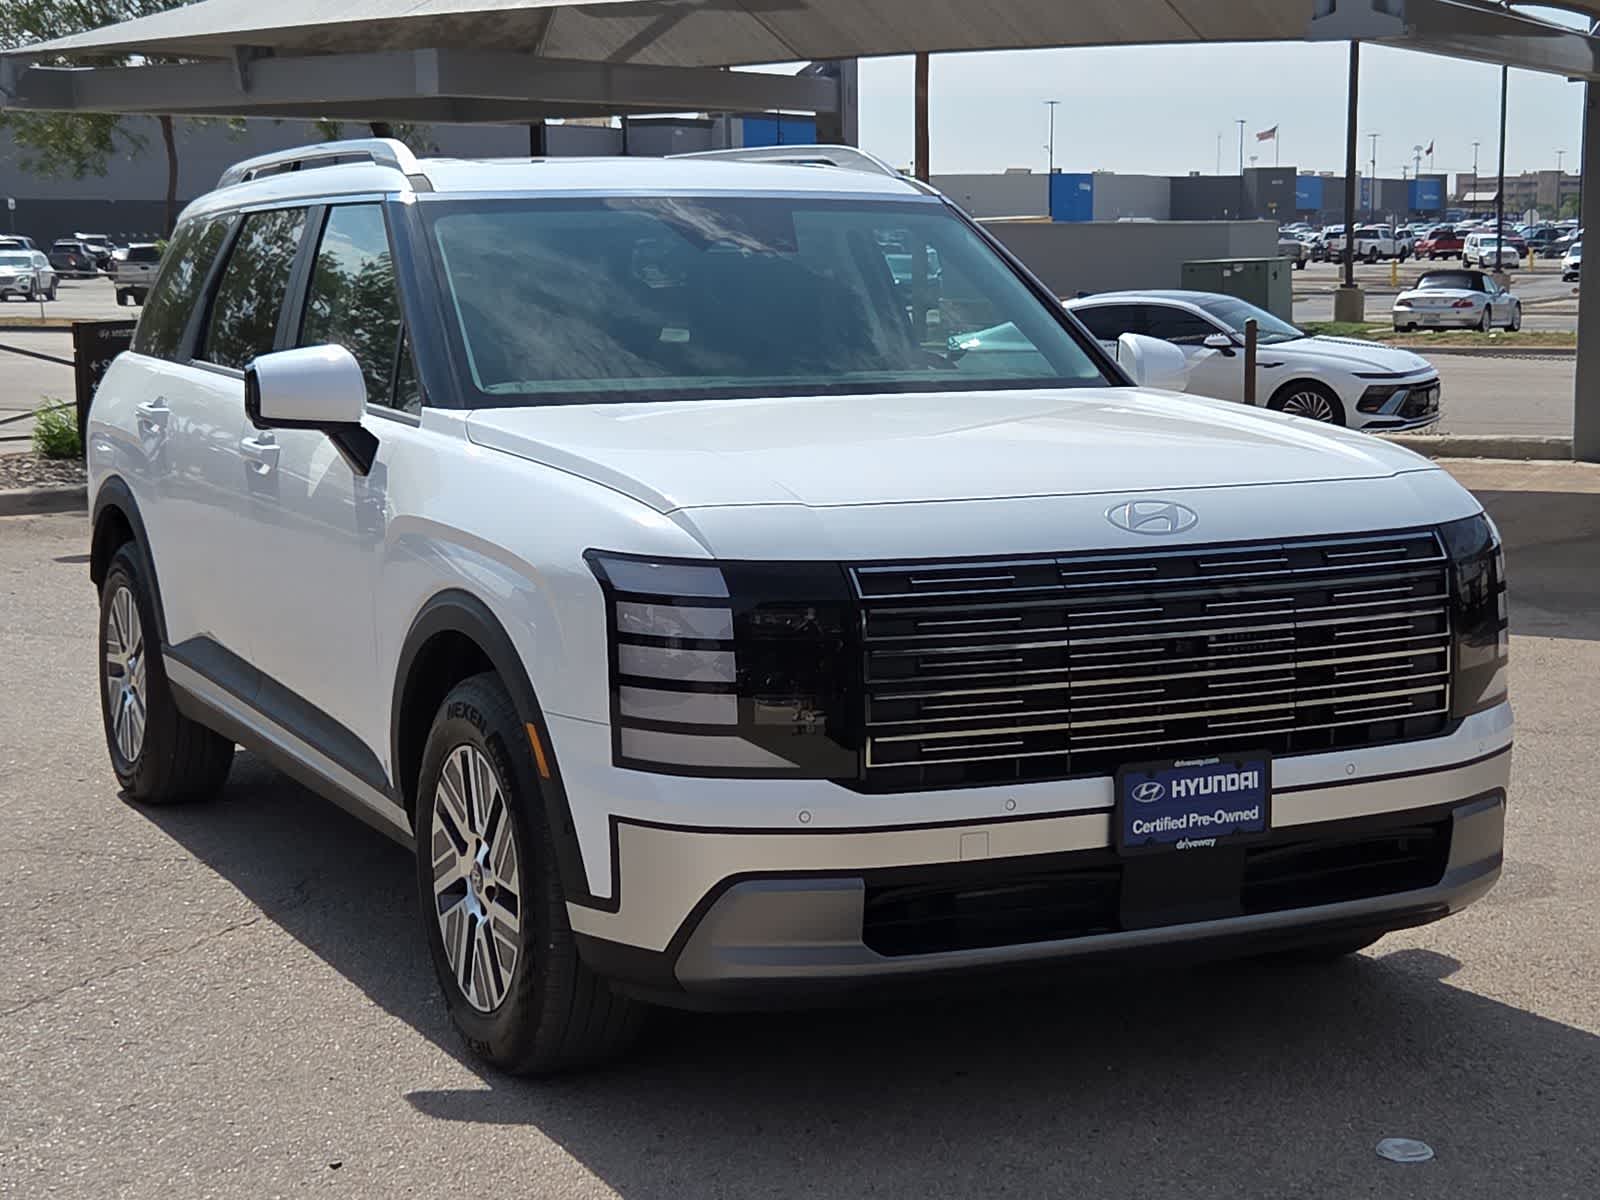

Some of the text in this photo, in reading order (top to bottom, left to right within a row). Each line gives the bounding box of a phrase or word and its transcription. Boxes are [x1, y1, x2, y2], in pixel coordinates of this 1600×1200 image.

[1171, 770, 1259, 798] HYUNDAI
[1132, 805, 1259, 834] Certified Pre-Owned
[1176, 838, 1217, 850] driveway
